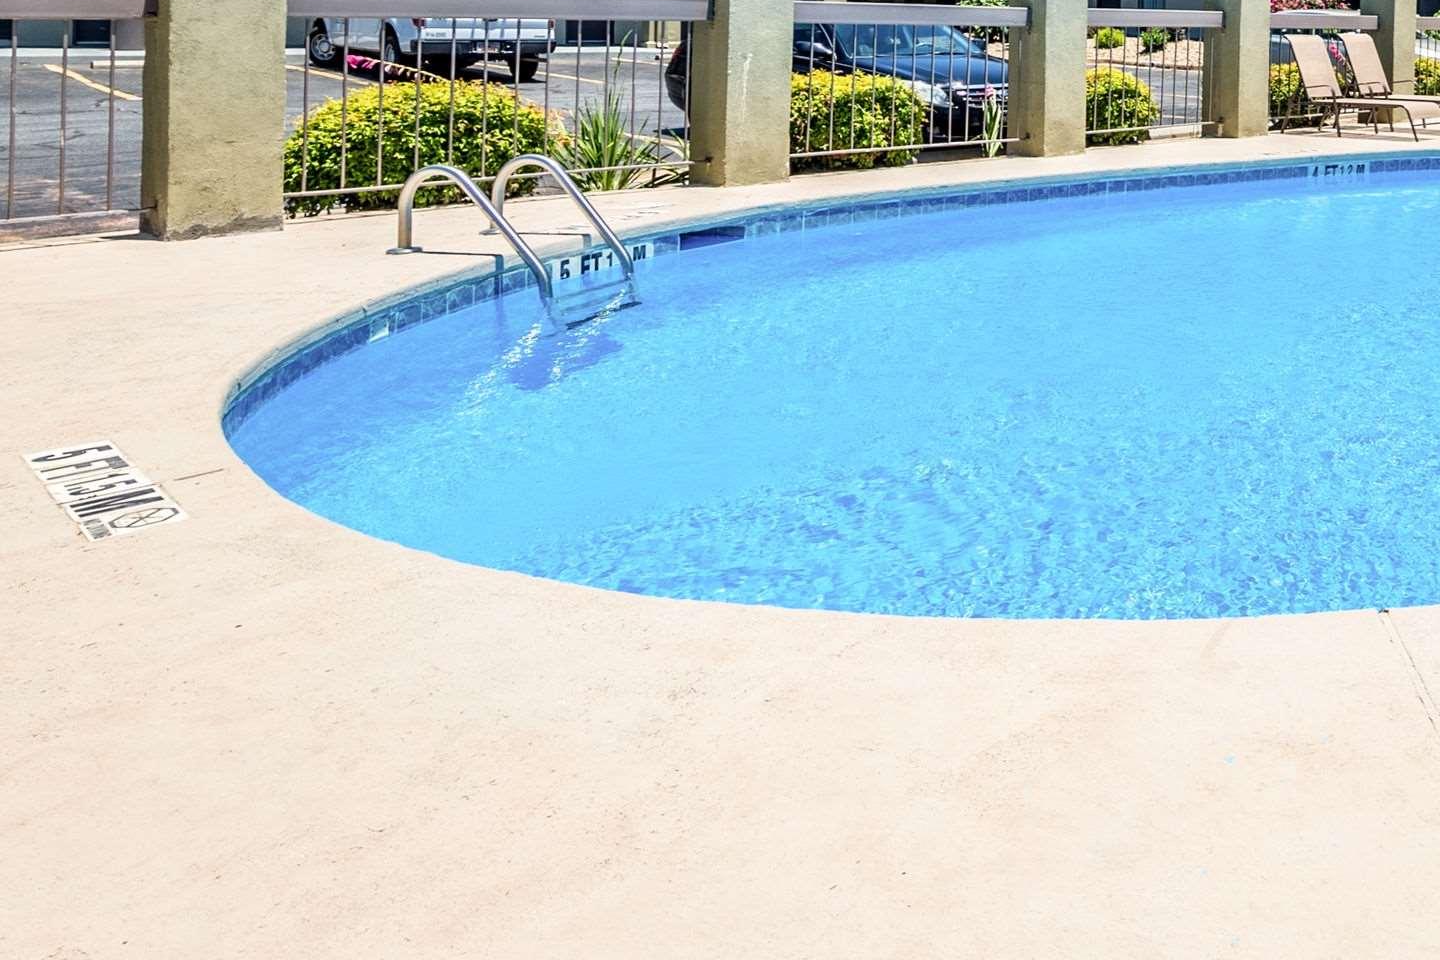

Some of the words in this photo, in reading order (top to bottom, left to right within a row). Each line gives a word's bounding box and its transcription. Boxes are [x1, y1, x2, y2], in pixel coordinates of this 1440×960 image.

[1325, 164, 1338, 176] FT
[1356, 164, 1365, 174] M
[560, 259, 570, 280] 5
[580, 252, 602, 275] FT
[633, 244, 646, 262] M
[32, 444, 113, 462] 5
[40, 456, 130, 481] FT
[70, 488, 164, 518] M
